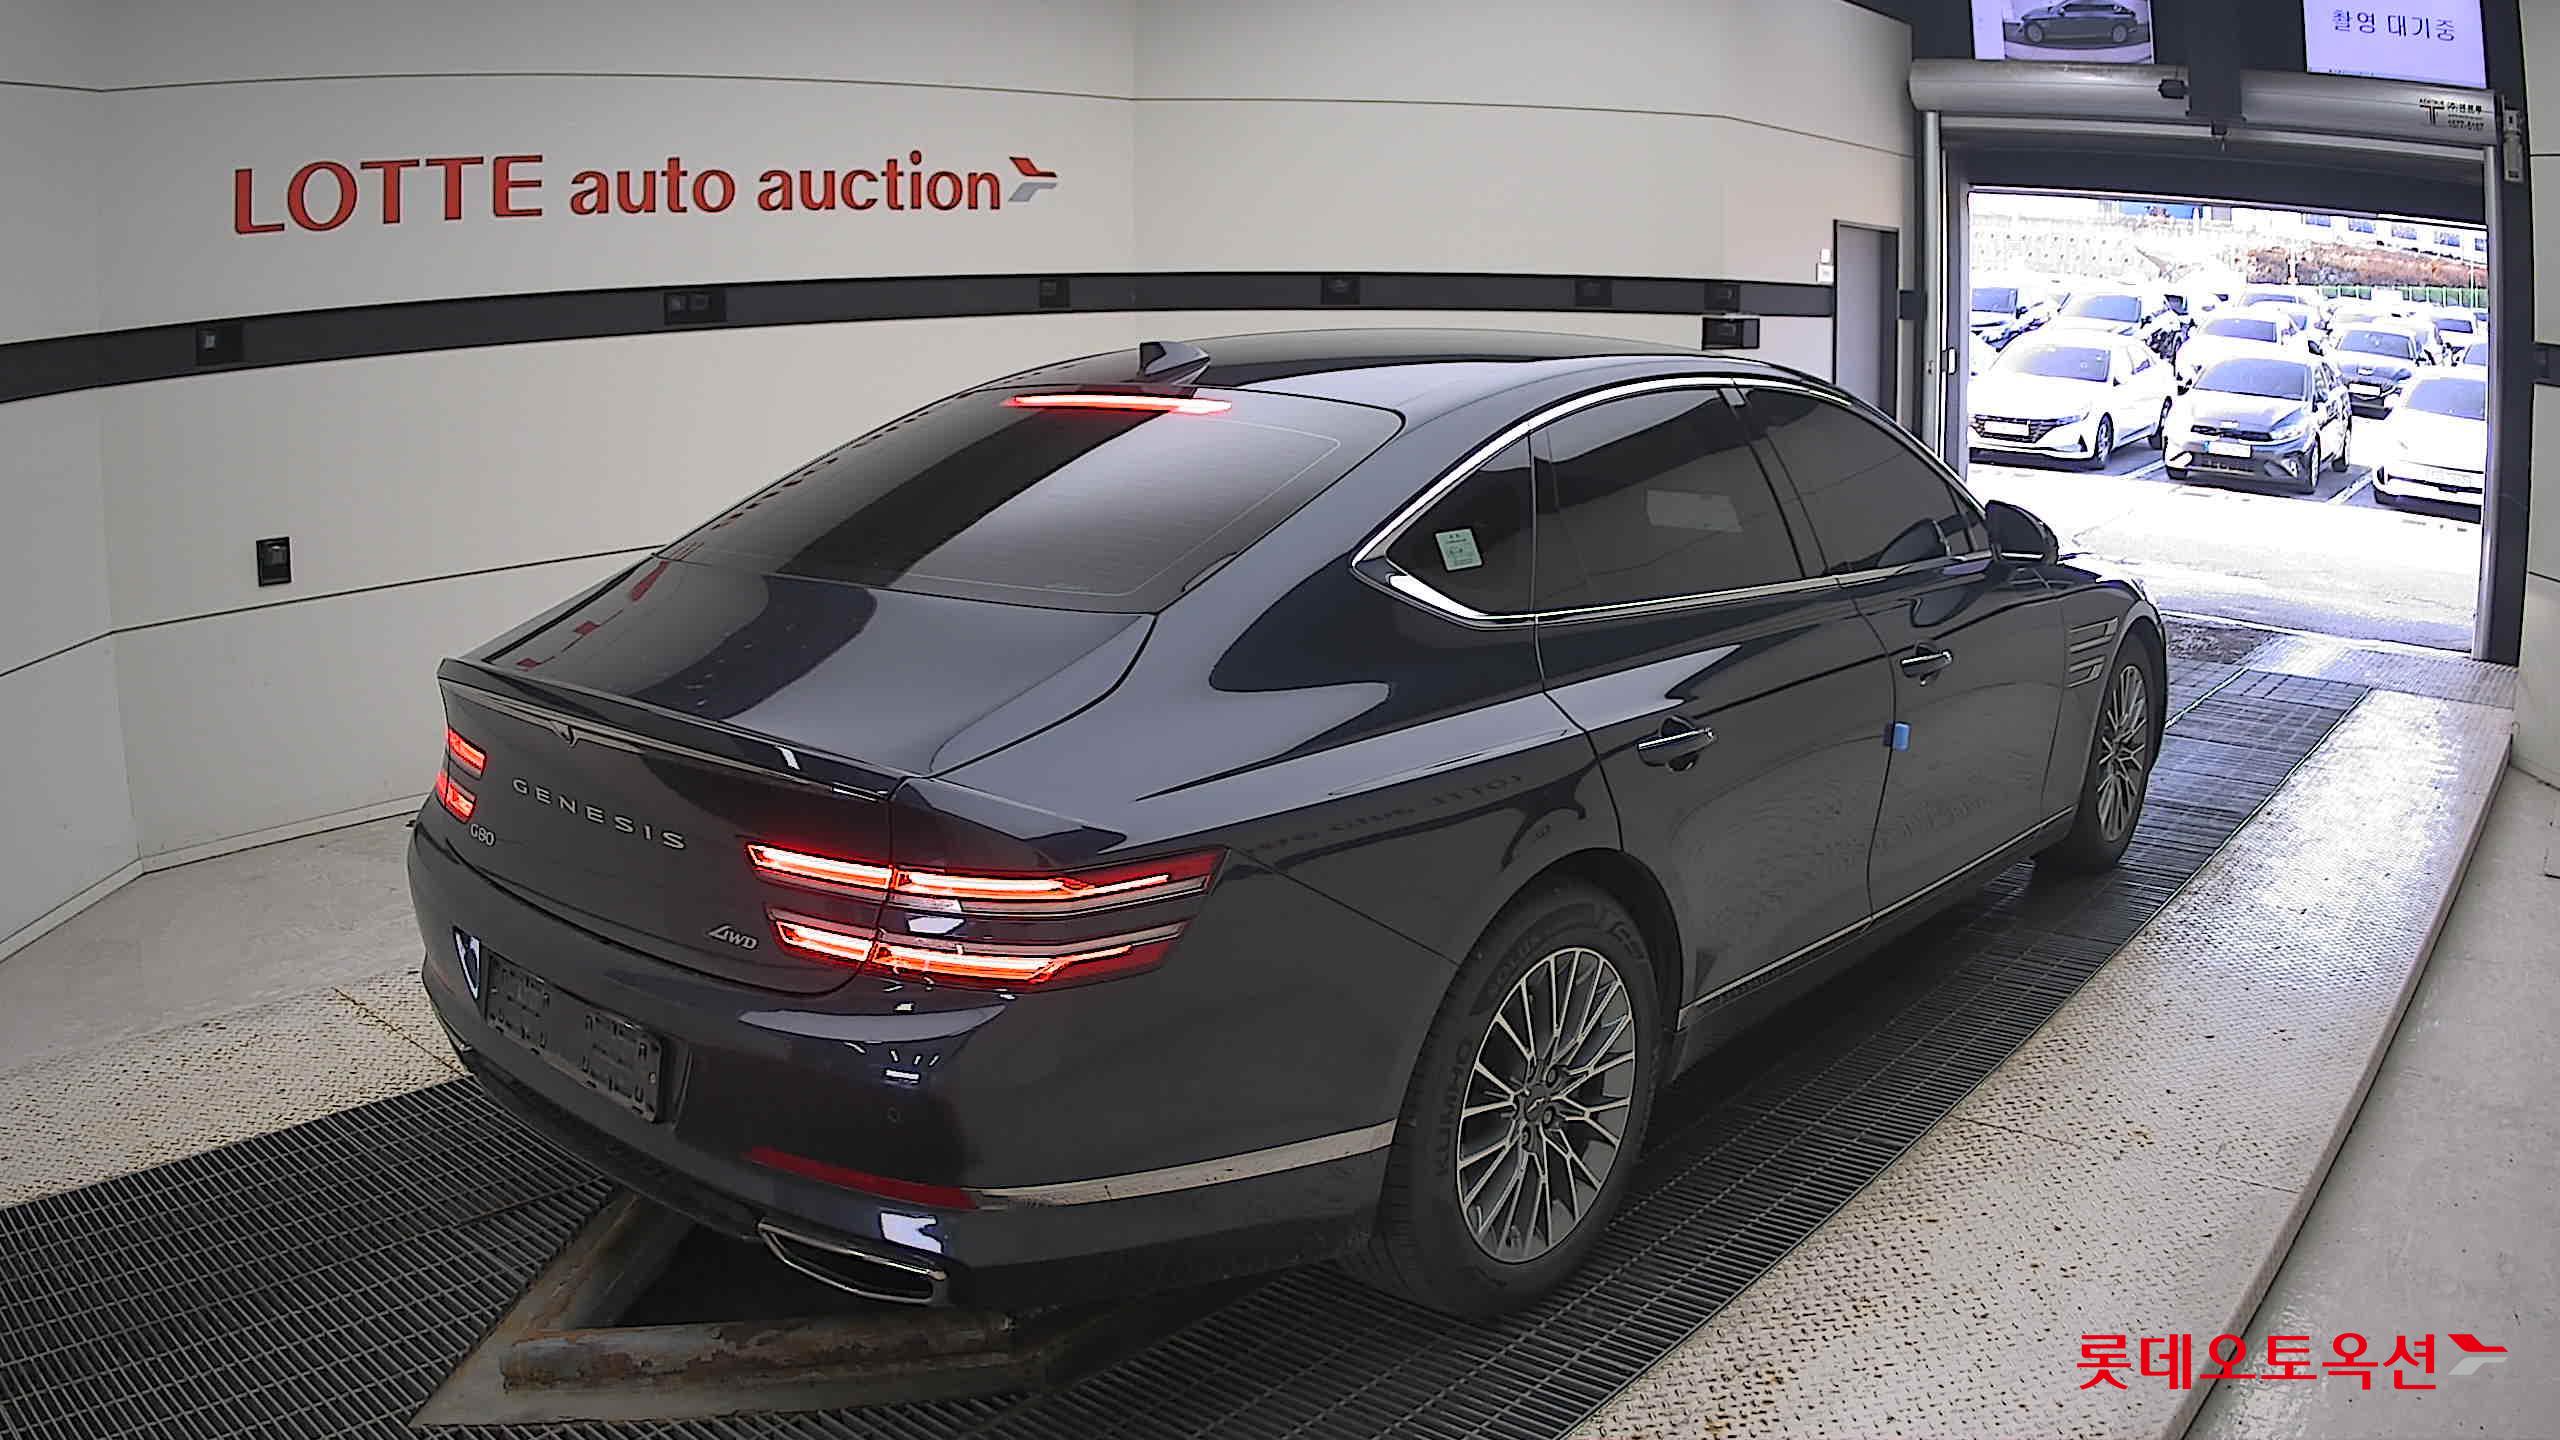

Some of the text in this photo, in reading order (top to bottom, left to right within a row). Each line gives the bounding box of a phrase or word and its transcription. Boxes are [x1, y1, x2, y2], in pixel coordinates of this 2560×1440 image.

[2332, 9, 2455, 41] 촬영 대기중
[234, 149, 1001, 234] LOTTE auto auction
[469, 822, 495, 846] G80
[512, 778, 686, 850] GENESIS
